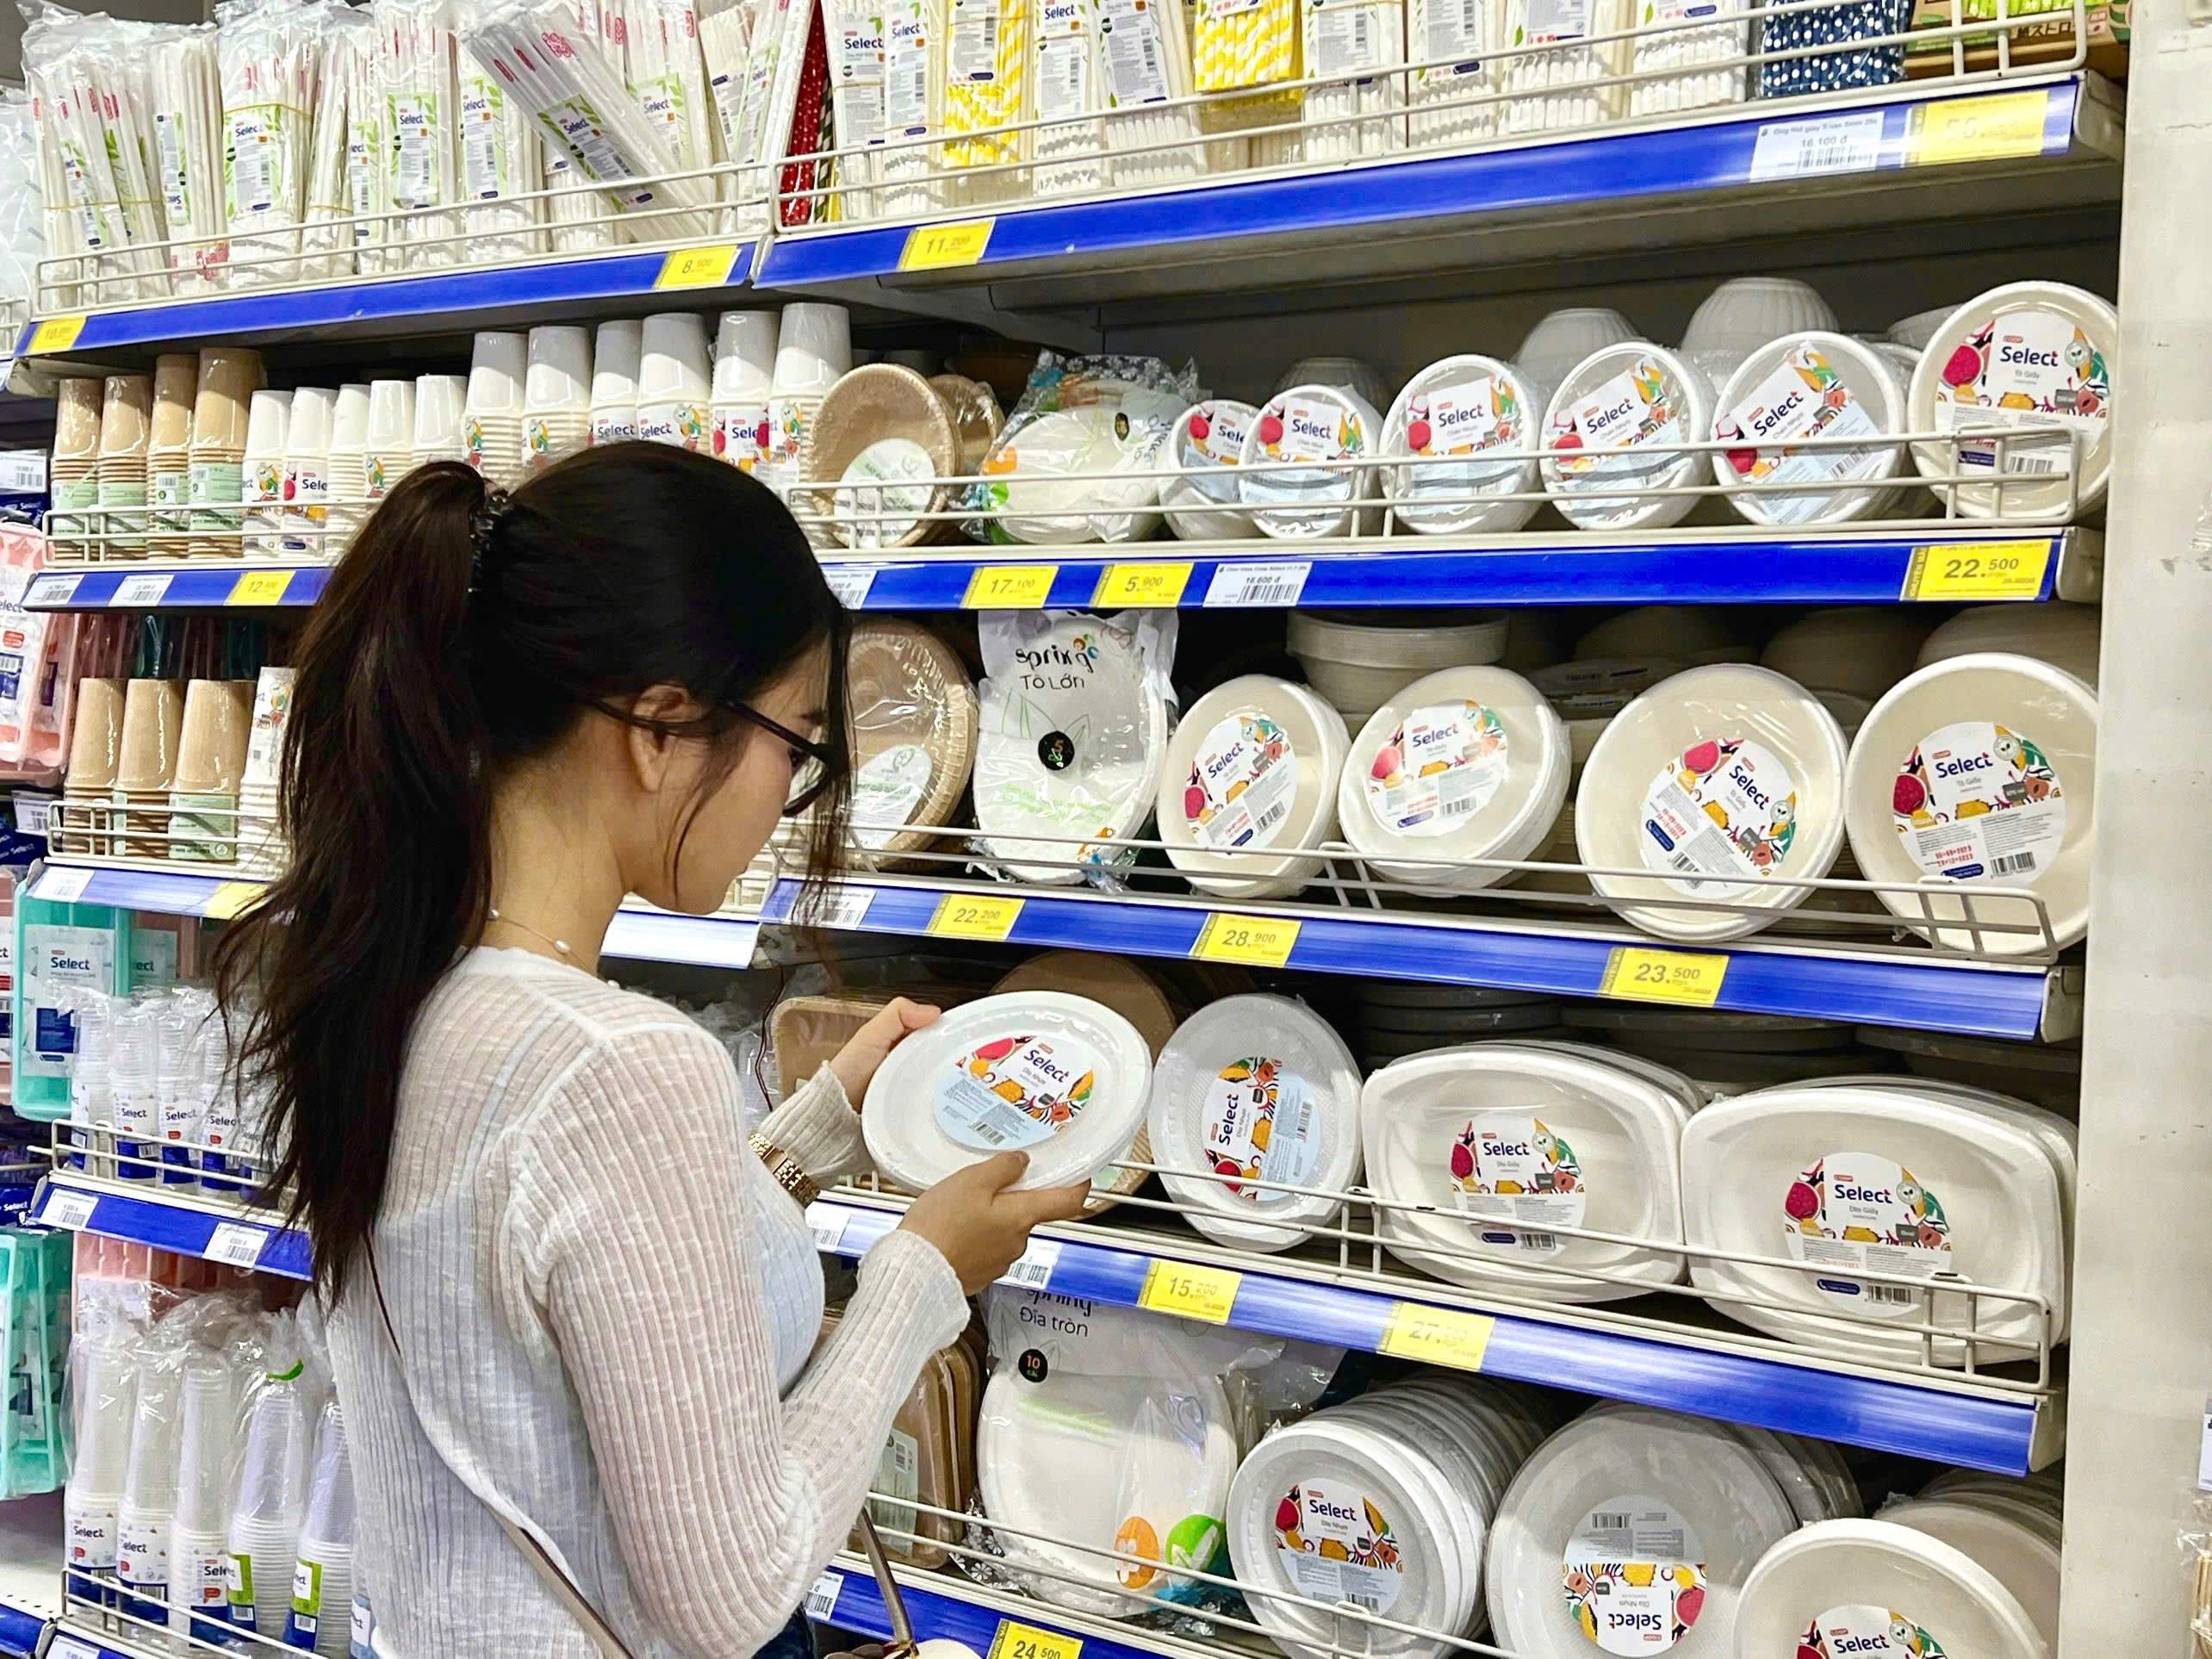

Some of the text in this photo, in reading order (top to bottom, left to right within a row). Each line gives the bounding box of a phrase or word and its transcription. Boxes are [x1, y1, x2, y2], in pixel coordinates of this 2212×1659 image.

[1044, 5, 1076, 21] Select
[892, 22, 921, 40] Select
[843, 36, 884, 50] Select
[463, 96, 486, 113] Select
[400, 113, 425, 126] Select
[562, 117, 590, 135] Select
[2000, 345, 2059, 367] Select
[1438, 403, 1485, 428] Select
[1586, 398, 1634, 434] Select
[1754, 391, 1804, 437] Select
[597, 423, 635, 439] Select
[640, 422, 673, 438] Select
[731, 426, 758, 439] Sele
[1217, 424, 1244, 443] Sele
[1292, 418, 1332, 440] Select
[301, 478, 328, 491] Sele
[0, 600, 22, 613] elect
[1048, 672, 1085, 690] Lớn
[1412, 723, 1459, 749] Select
[1208, 742, 1245, 779] Select
[1936, 752, 1993, 778] Select
[1729, 764, 1769, 811] Select
[50, 956, 90, 971] Select
[136, 960, 154, 972] ect
[1023, 1048, 1070, 1084] Select
[209, 1115, 235, 1127] Selec
[1218, 1093, 1239, 1146] Select
[1483, 1141, 1531, 1156] Select
[1834, 1184, 1893, 1204] Select
[1052, 1314, 1089, 1338] tròn
[1308, 1499, 1358, 1522] Select
[73, 1525, 105, 1538] Select
[122, 1541, 147, 1554] elect
[204, 1565, 227, 1577] Sele
[1608, 1613, 1662, 1631] Select
[1833, 1634, 1890, 1654] Select
